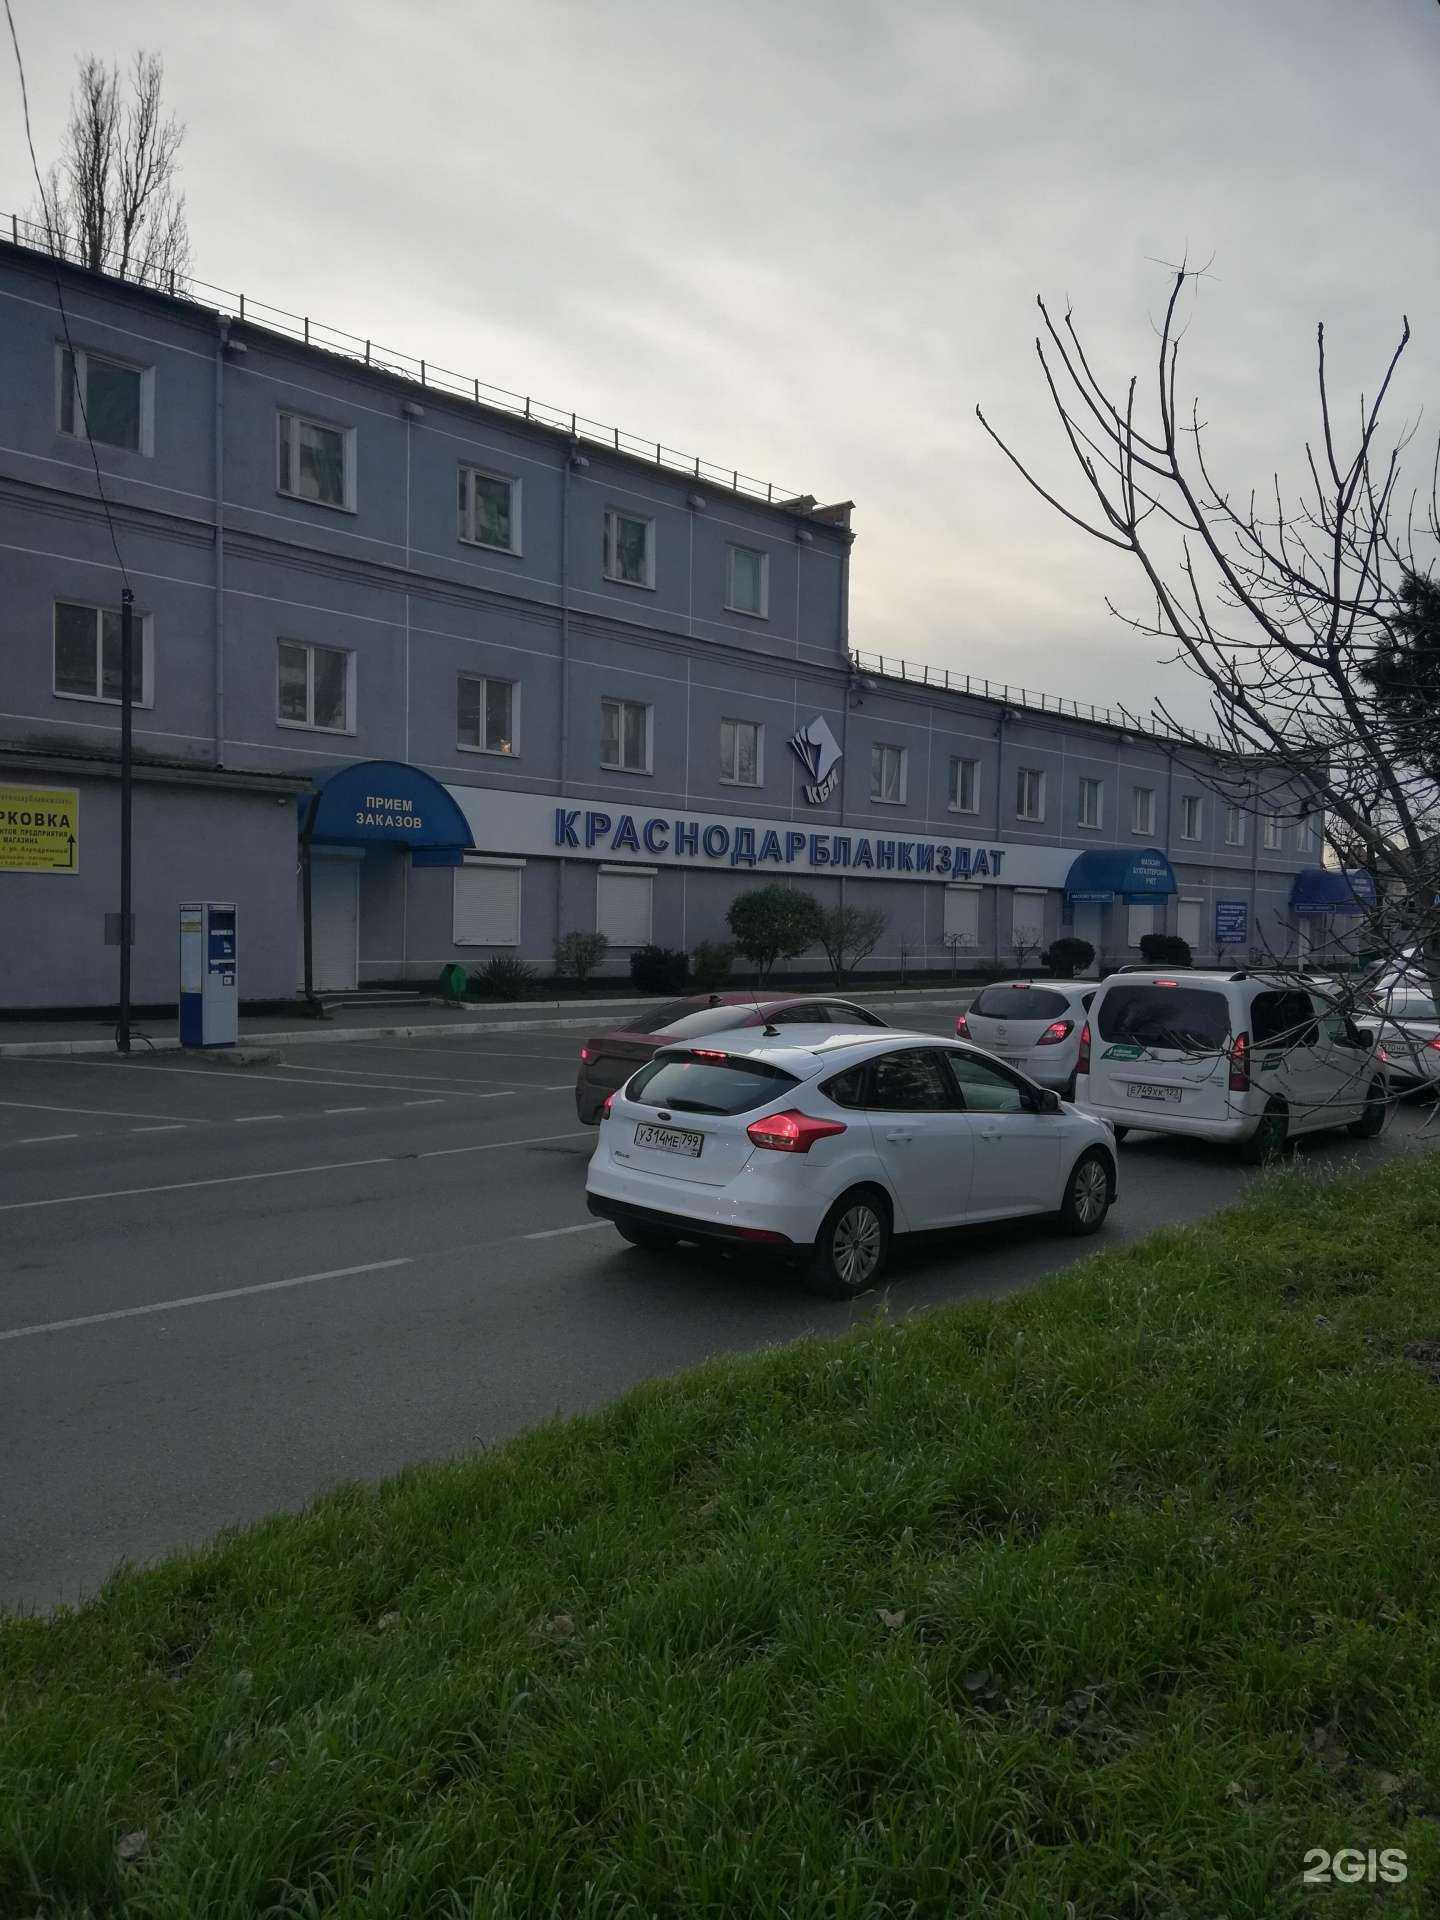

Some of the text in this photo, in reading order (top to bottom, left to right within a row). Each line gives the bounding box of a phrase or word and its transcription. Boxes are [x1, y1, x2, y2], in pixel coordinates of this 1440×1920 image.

[804, 768, 839, 804] КБИ
[366, 796, 413, 812] ПРИЕМ
[356, 812, 422, 829] ЗАКАЗОВ
[554, 808, 1005, 880] КРАСНОДАРБЛАНКИЗДАТ
[681, 1133, 699, 1147] 799
